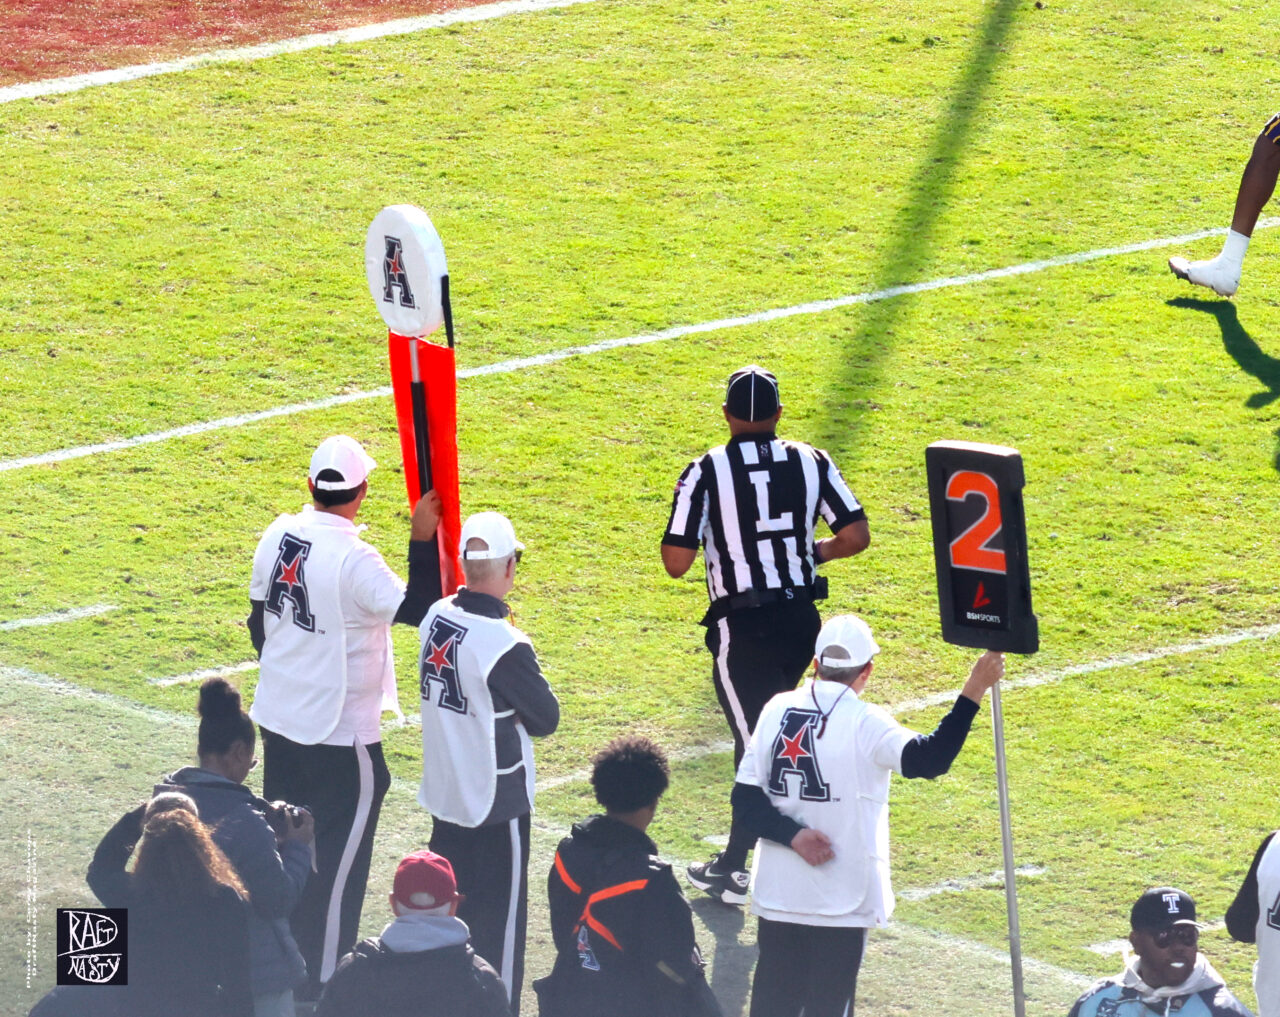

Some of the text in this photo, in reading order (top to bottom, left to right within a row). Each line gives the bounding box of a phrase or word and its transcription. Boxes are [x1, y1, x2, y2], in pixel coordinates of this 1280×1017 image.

[383, 235, 415, 309] A
[749, 471, 794, 533] L
[945, 470, 1007, 574] 2
[264, 532, 315, 633] A
[420, 614, 468, 715] A
[769, 707, 831, 802] A
[1162, 893, 1180, 913] T
